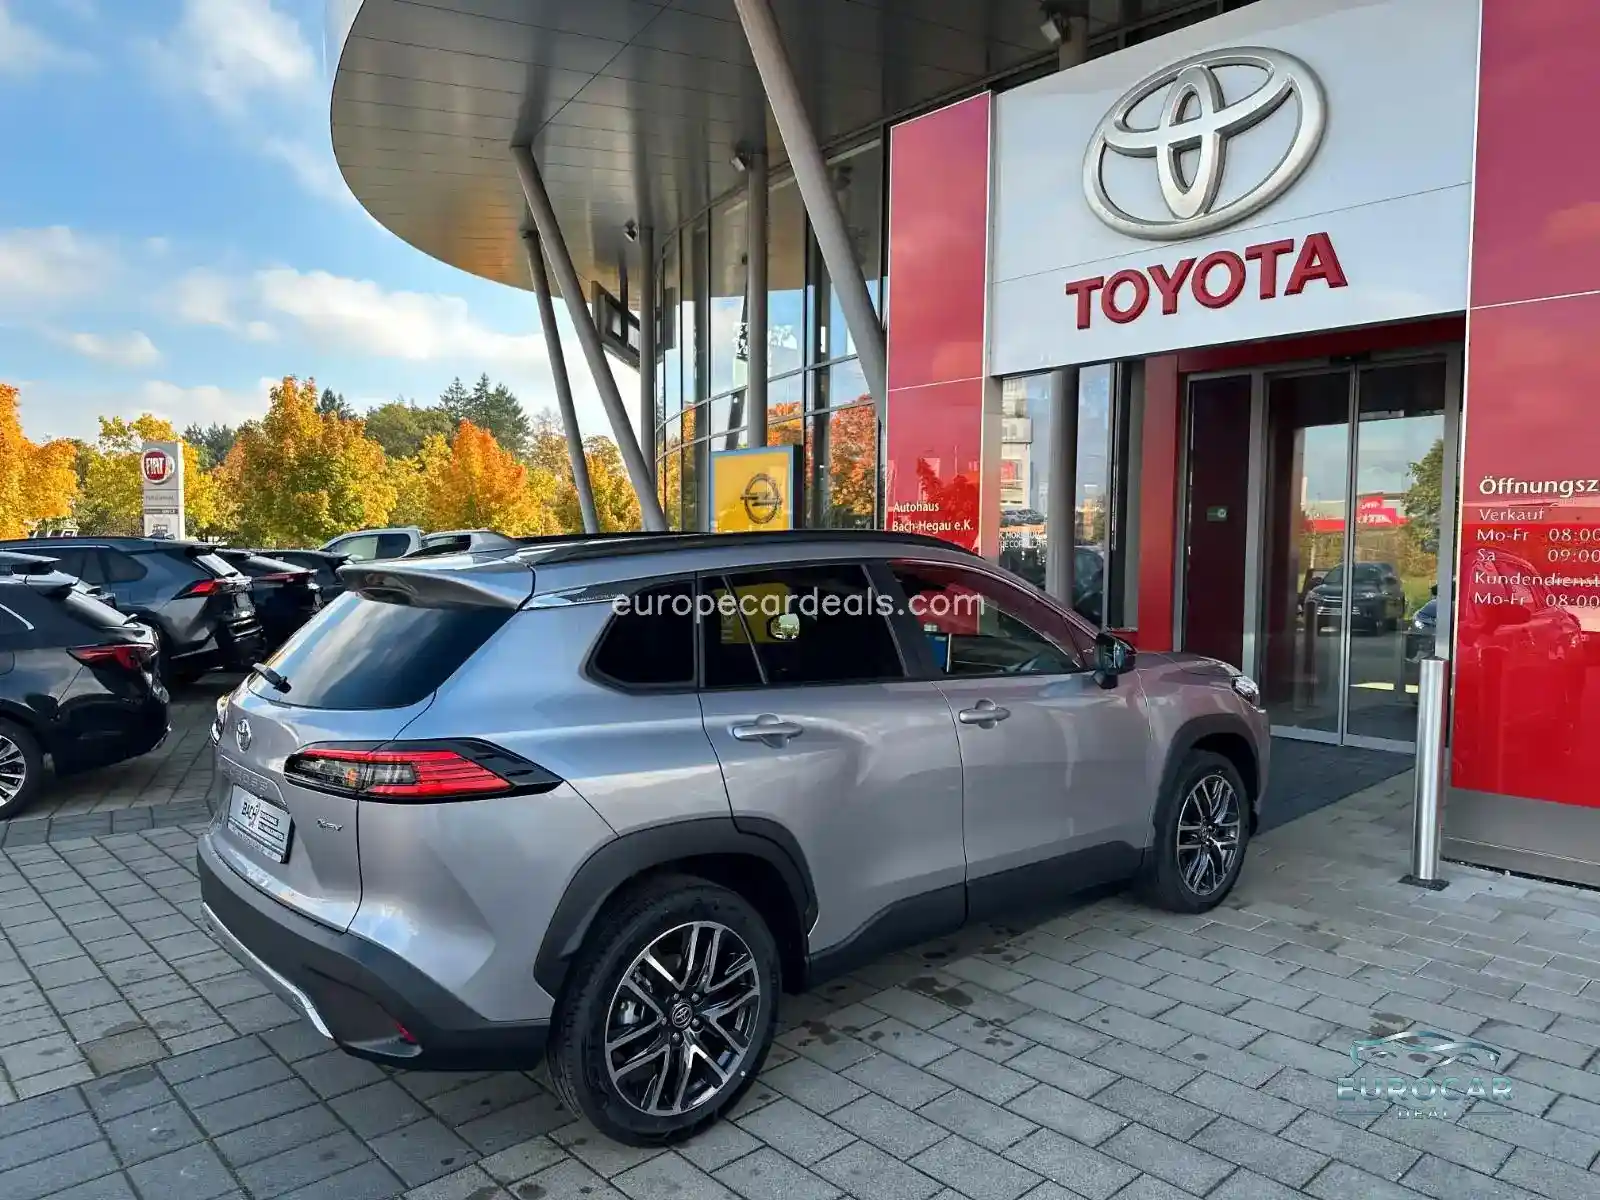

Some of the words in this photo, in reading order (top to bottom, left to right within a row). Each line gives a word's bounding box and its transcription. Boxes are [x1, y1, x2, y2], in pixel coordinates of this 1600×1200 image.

[1066, 232, 1348, 329] TOYOTA
[145, 457, 164, 475] FIAT
[1479, 476, 1599, 498] Öffnungsz
[893, 501, 940, 513] Autohaus
[1479, 507, 1545, 521] Verkauf
[892, 520, 951, 534] Bach-Hegau
[954, 519, 974, 531] e.K.
[1477, 528, 1530, 541] Mo-Fr
[1549, 528, 1600, 542] 08:00
[1477, 549, 1496, 562] Sa
[1547, 549, 1600, 563] 09:00
[1474, 571, 1600, 587] Kundendienst
[1474, 592, 1526, 606] Mo-Fr
[1545, 593, 1600, 609] 08:00
